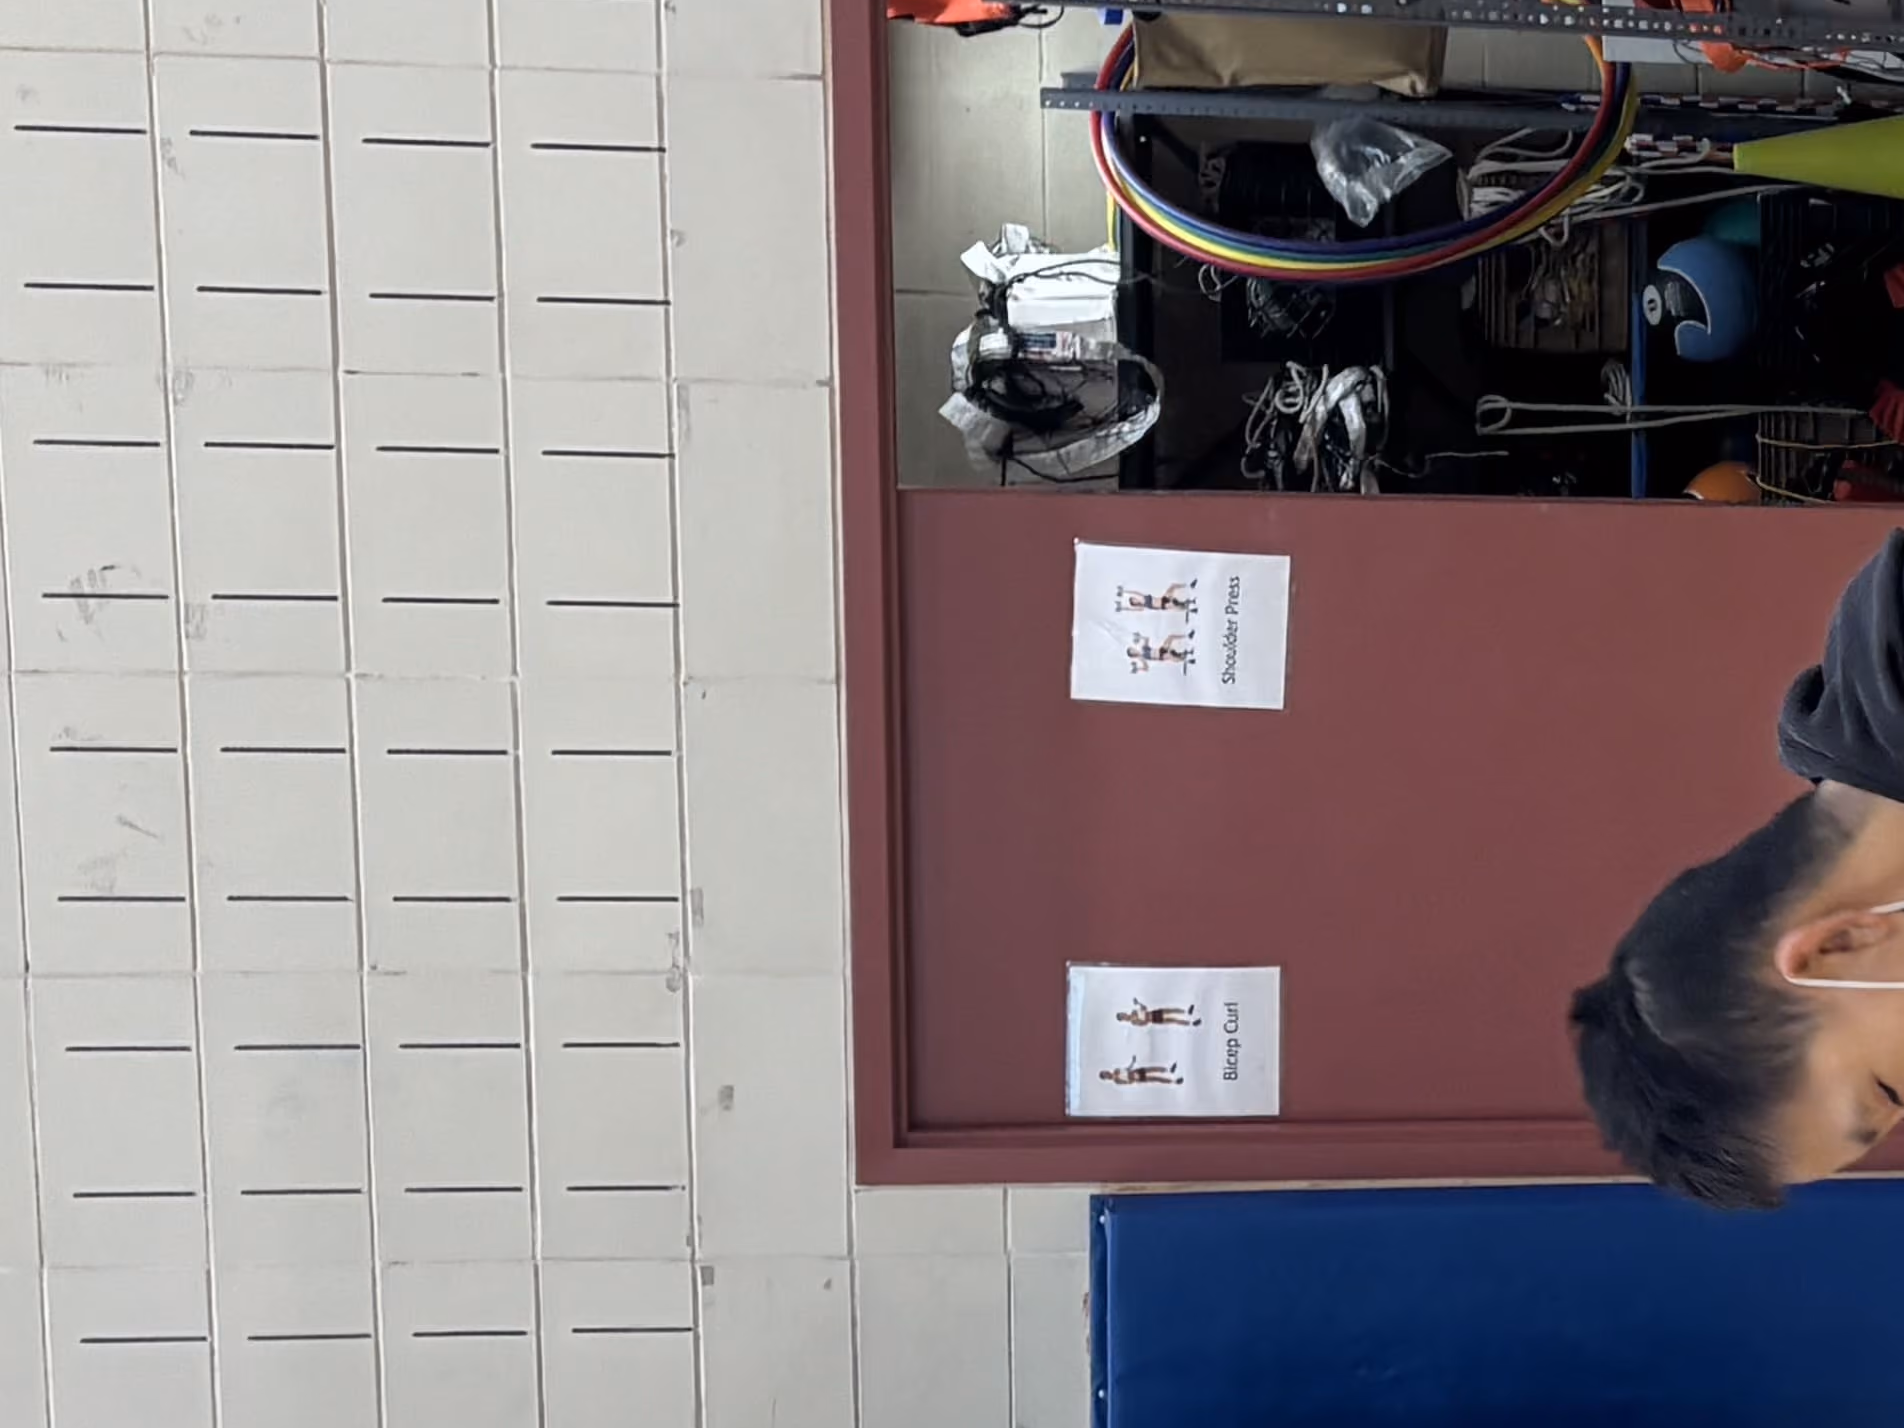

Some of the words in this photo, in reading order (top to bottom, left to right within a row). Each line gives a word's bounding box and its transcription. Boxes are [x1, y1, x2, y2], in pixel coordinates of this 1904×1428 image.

[1224, 575, 1242, 615] Press
[1221, 618, 1241, 684] Shoulder
[1223, 1001, 1240, 1034] Curl
[1223, 1037, 1243, 1080] Bicep
